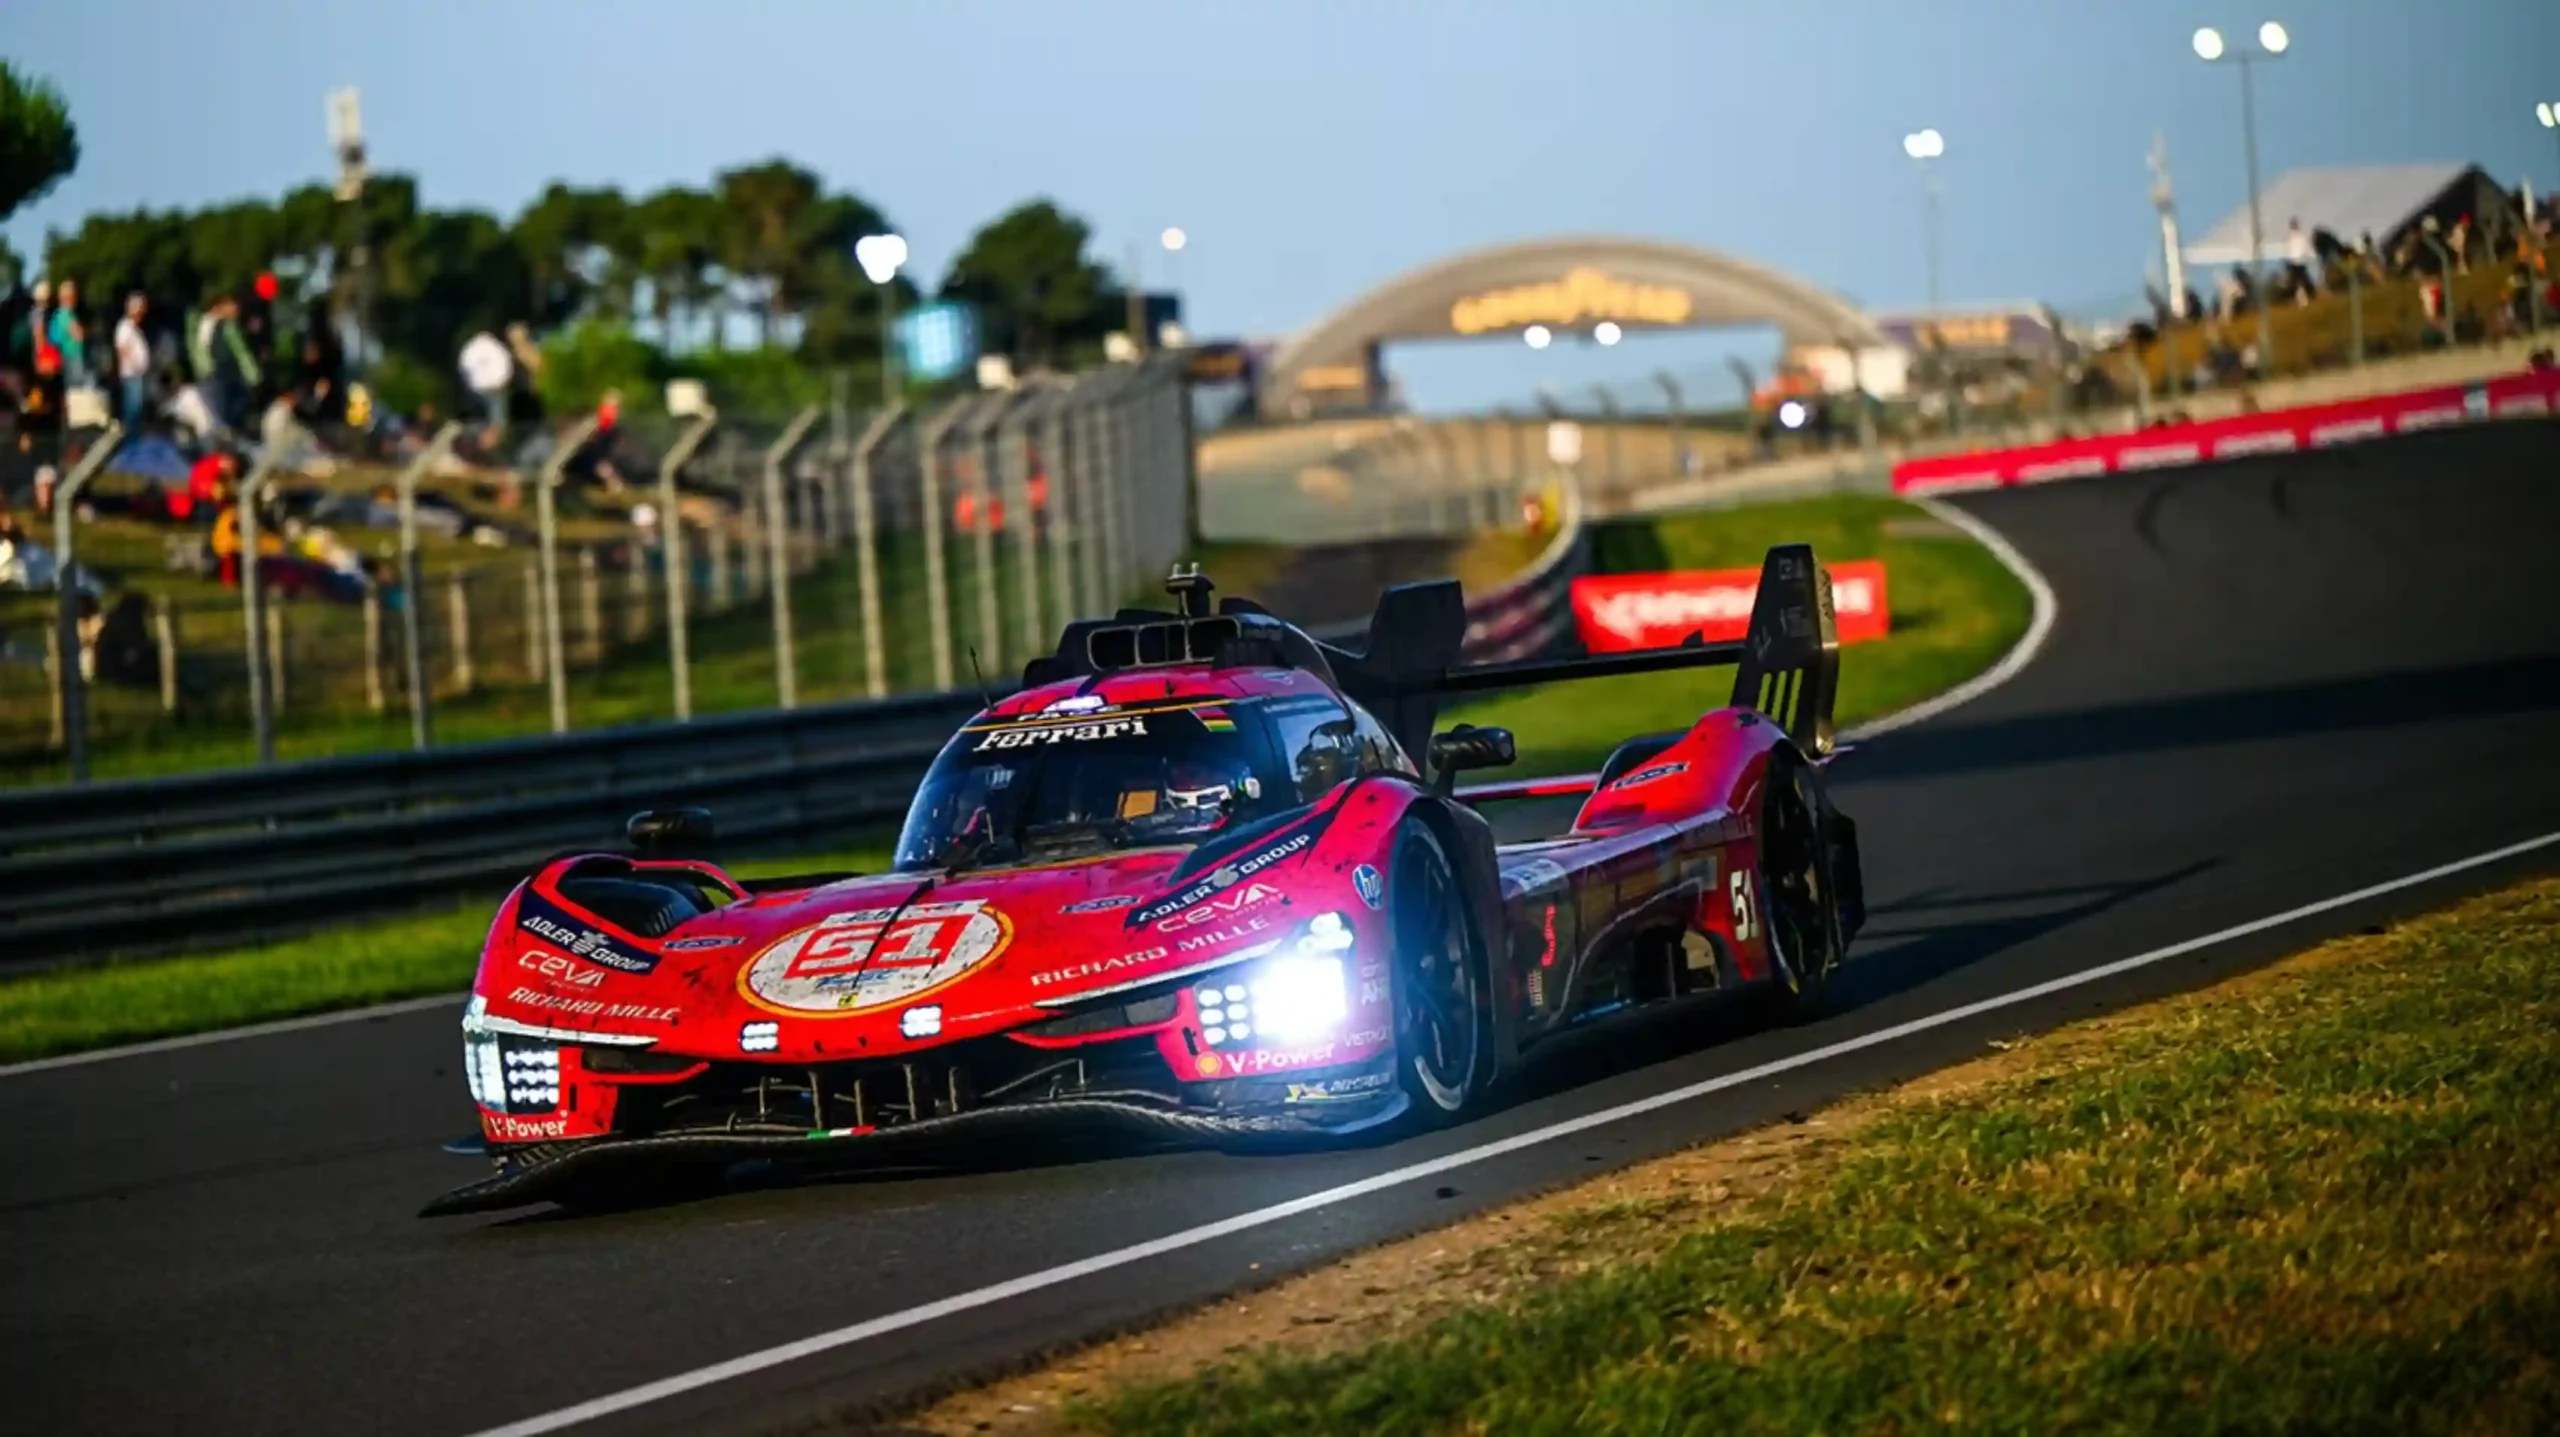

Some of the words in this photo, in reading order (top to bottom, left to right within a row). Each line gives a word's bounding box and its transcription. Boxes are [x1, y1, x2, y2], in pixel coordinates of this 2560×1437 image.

[973, 717, 1148, 751] Ferrari
[1138, 885, 1214, 922] ADLER
[1239, 833, 1311, 875] GROUP
[1730, 867, 1759, 941] 51
[522, 915, 577, 947] ADLER
[589, 947, 652, 971] GROUP
[797, 920, 944, 972] 51
[1030, 945, 1168, 987] RICHARD
[1176, 914, 1270, 952] MILLE
[507, 986, 605, 1014] RICHARD
[605, 1003, 682, 1021] MILLE
[1226, 1042, 1335, 1073] V-Power
[489, 1116, 567, 1138] V-Power
